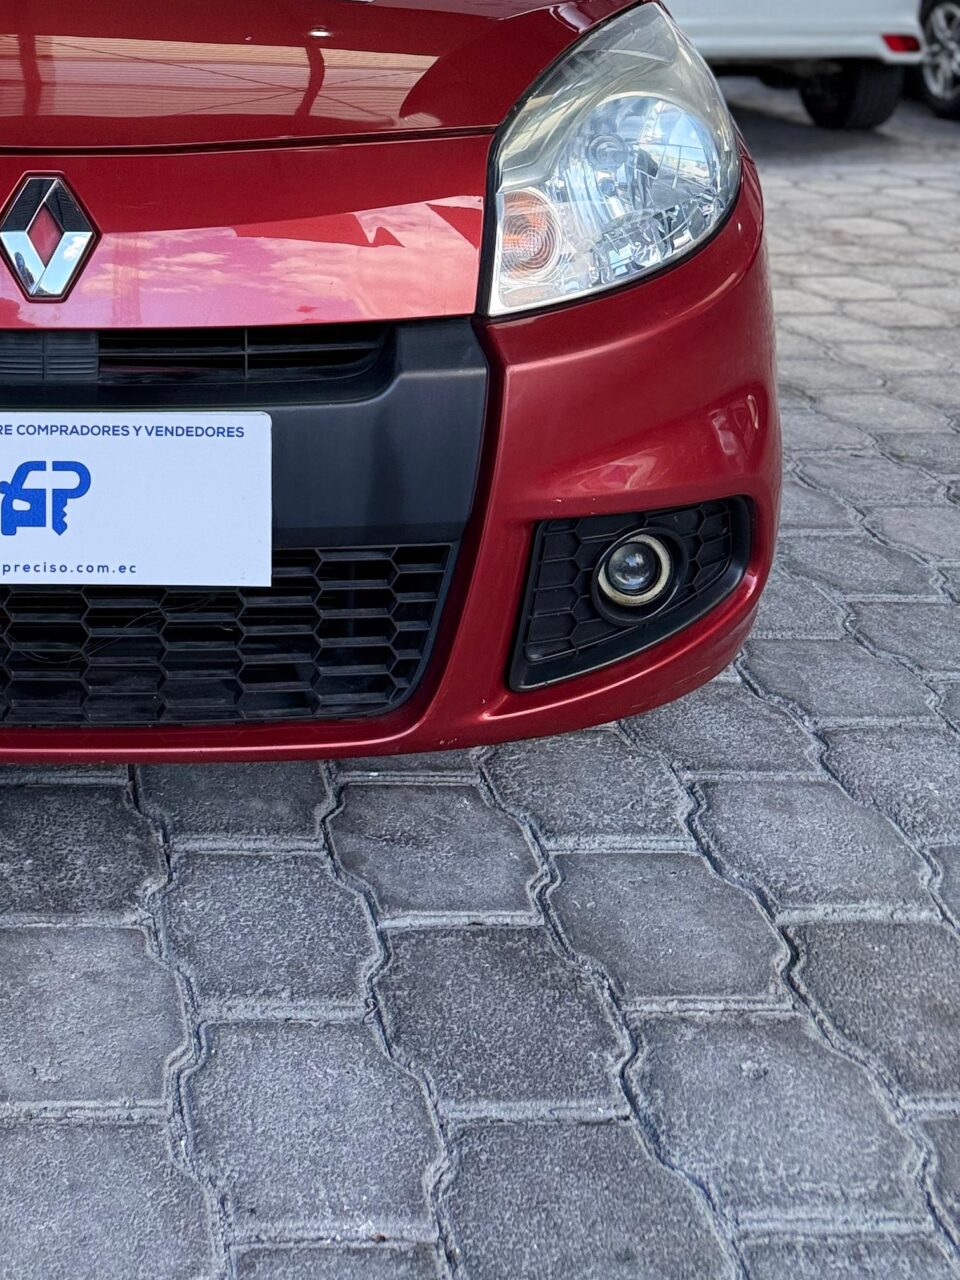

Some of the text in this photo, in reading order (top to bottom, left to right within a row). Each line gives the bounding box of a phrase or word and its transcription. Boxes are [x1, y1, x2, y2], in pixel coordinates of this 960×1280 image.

[16, 424, 130, 437] COMPRADORES
[134, 425, 143, 437] Y
[144, 425, 245, 438] VENDEDORES
